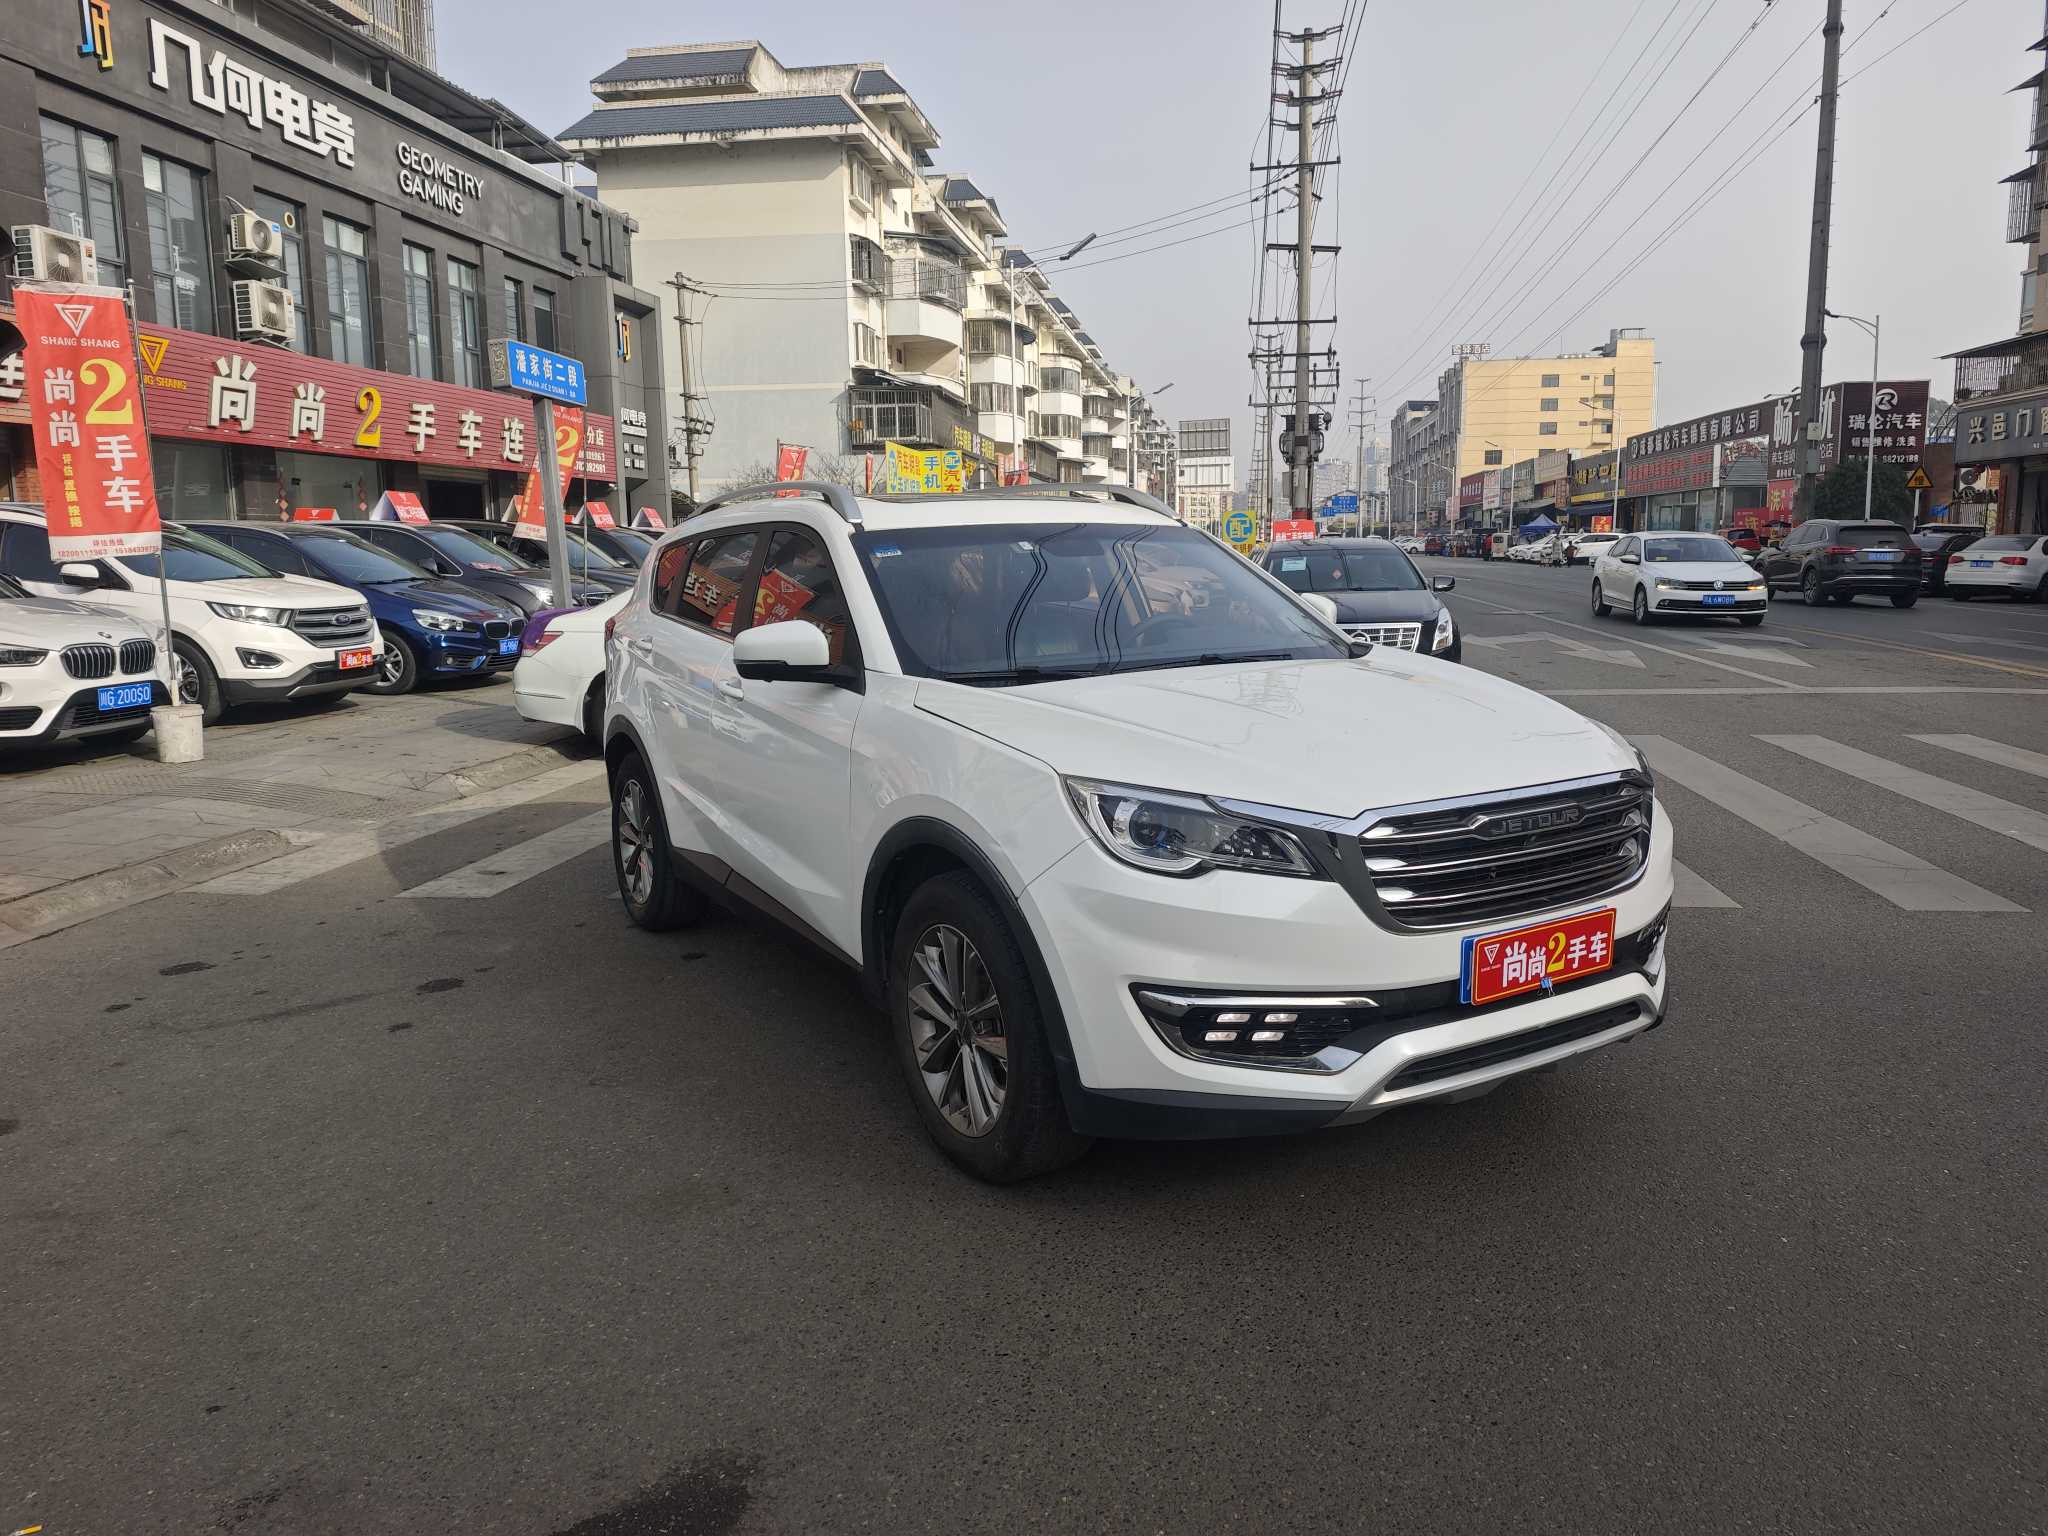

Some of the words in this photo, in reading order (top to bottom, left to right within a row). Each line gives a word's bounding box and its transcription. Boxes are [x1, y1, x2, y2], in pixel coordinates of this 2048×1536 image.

[150, 18, 355, 168] 几何电竞
[398, 141, 484, 198] GEOMETRY
[400, 169, 464, 214] GAMING
[41, 335, 77, 346] SHANG
[80, 338, 120, 349] SHANG
[515, 348, 578, 388] 潘家街二段
[1848, 412, 1922, 430] 瑞伦汽车
[924, 456, 941, 488] 手机
[1489, 809, 1579, 835] JETOUR
[1502, 931, 1608, 988] 尚尚2手车
